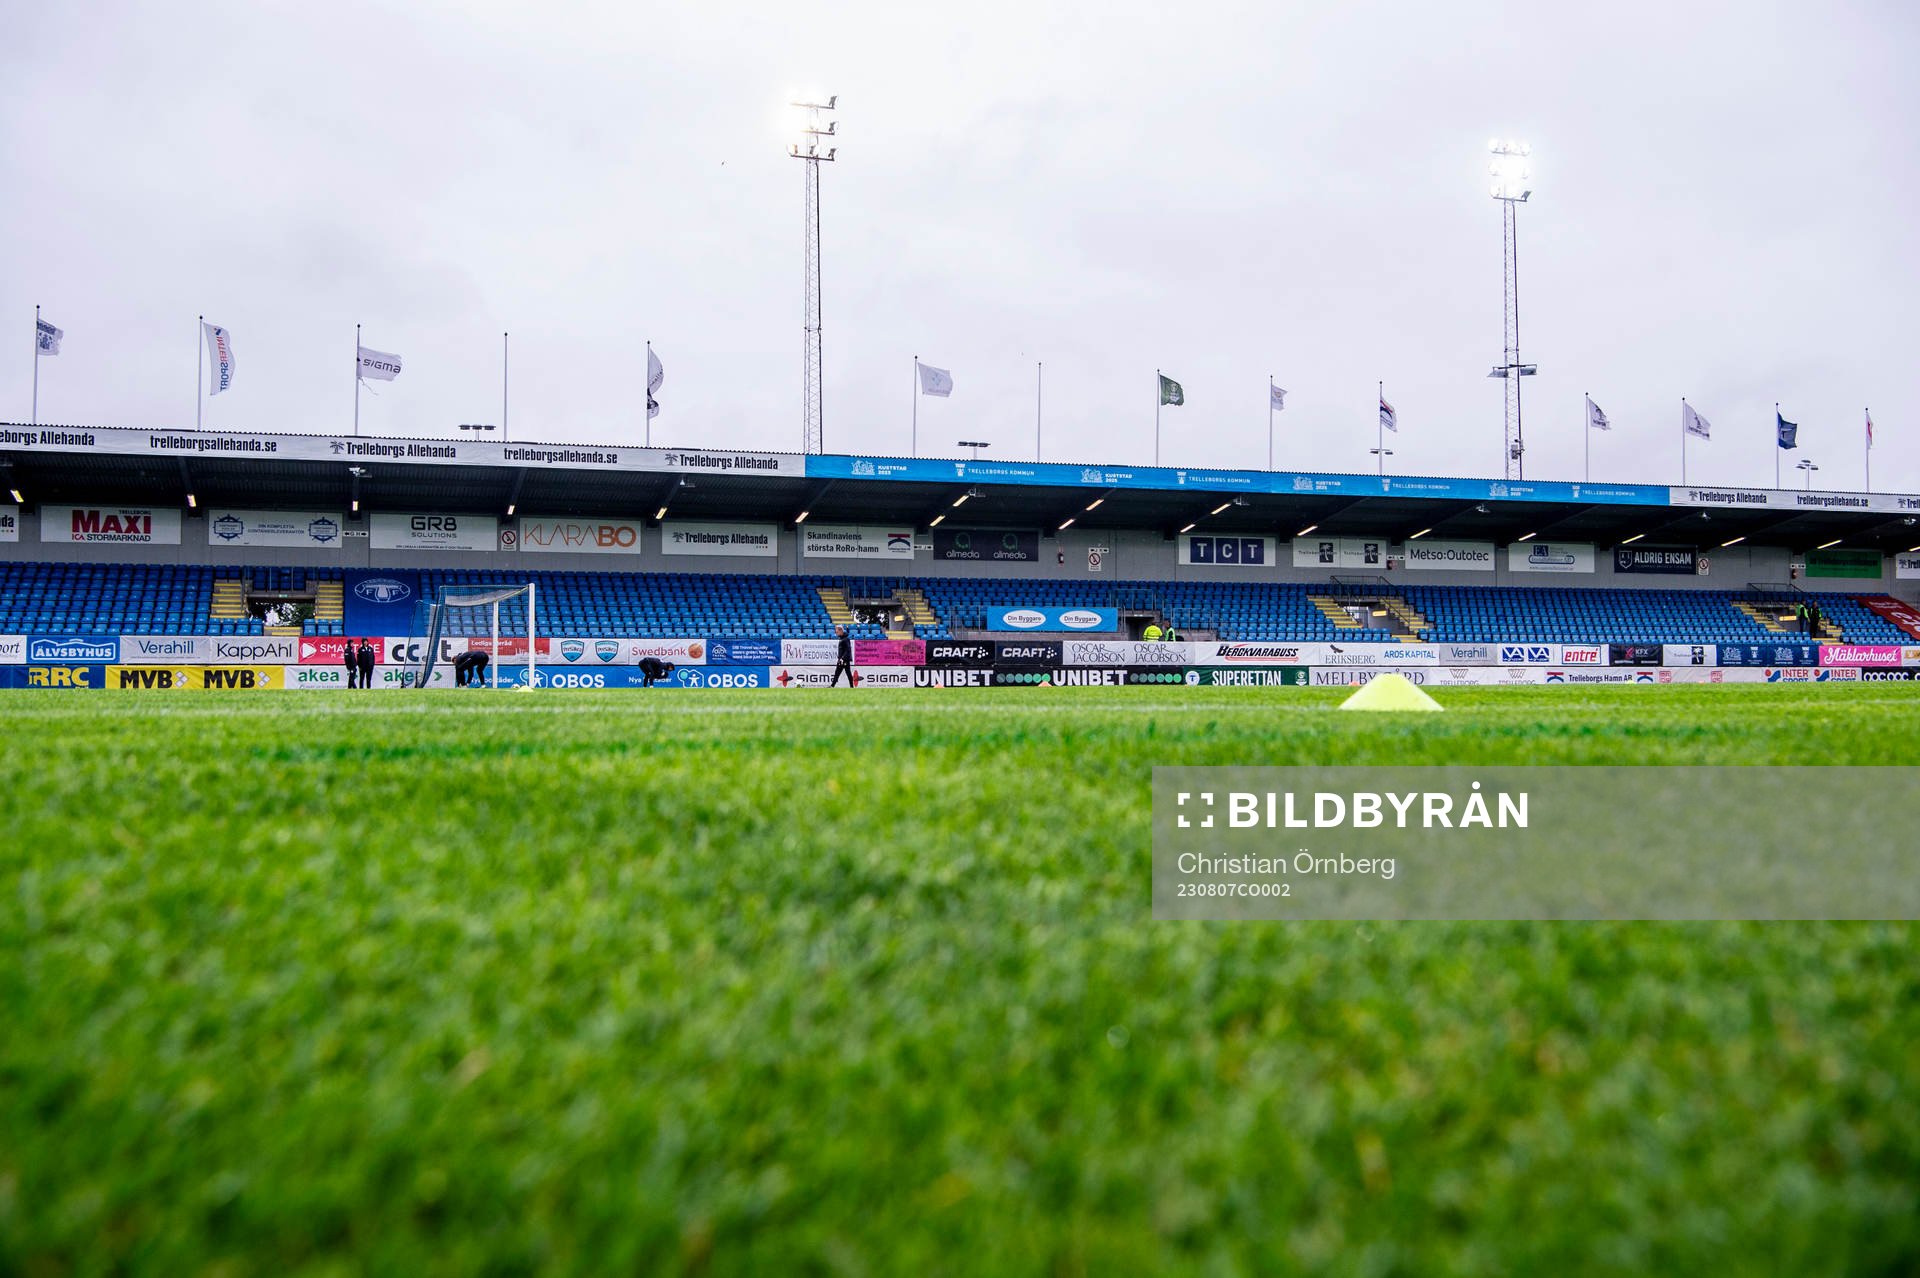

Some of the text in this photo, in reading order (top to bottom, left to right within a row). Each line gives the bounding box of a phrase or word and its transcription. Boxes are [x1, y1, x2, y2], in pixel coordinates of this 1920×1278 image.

[40, 431, 95, 446] Allehanda
[150, 435, 277, 452] trelleborgsallehanda.se
[346, 442, 456, 458] Trelleborgs Allehanda
[504, 448, 618, 464] trelleborgsallehanda.se
[680, 454, 779, 470] Trelleborgs Allehanda
[1698, 491, 1767, 504] Trelleborgs Allehanda
[1797, 495, 1869, 507] trelleborgsallehanda.se
[72, 509, 151, 534] MAXI
[411, 516, 457, 531] GR8
[87, 534, 151, 542] STORMARKNAD
[524, 523, 637, 548] KLARABO
[685, 532, 768, 545] Trelleborgs Allehanda
[807, 531, 862, 540] Skandinaviens
[807, 543, 834, 552] största
[836, 544, 879, 553] RoRo-hamn
[1410, 549, 1489, 561] Metso:Outotec
[1634, 552, 1692, 564] ALDRIG ENSAM
[1018, 615, 1042, 623] Byggare
[35, 646, 112, 657] ÄLVSBYHUS
[139, 640, 194, 654] Verahill
[217, 643, 292, 660] KappAhl
[631, 646, 687, 656] Swedbank
[933, 647, 977, 657] CRAFT
[1002, 647, 1045, 658] CRAFT
[1072, 643, 1107, 652] OSCAR
[1134, 643, 1168, 652] OSCAR
[1216, 645, 1300, 657] BERGKVARABUSS
[1451, 647, 1488, 658] Verahill
[1072, 653, 1126, 663] JACOBSON
[1134, 653, 1186, 663] JACOBSON
[1325, 655, 1376, 664] ERIKSBERG
[1384, 650, 1437, 659] AROS KAPITAL
[1564, 648, 1599, 662] entré
[1824, 647, 1898, 665] Mäklarhuset
[28, 667, 89, 686] RRC
[120, 670, 173, 688] MVB
[204, 670, 255, 688] MVB
[298, 668, 339, 682] akea
[915, 669, 993, 687] UNIBET
[1053, 669, 1127, 686] UNIBET
[1212, 670, 1282, 686] SUPERETTAN
[1568, 674, 1603, 683] Trelleborgs
[1782, 669, 1808, 677] INTER
[1831, 669, 1856, 677] INTER
[552, 674, 605, 688] OBOS
[628, 676, 642, 684] Nya
[708, 674, 758, 688] OBOS
